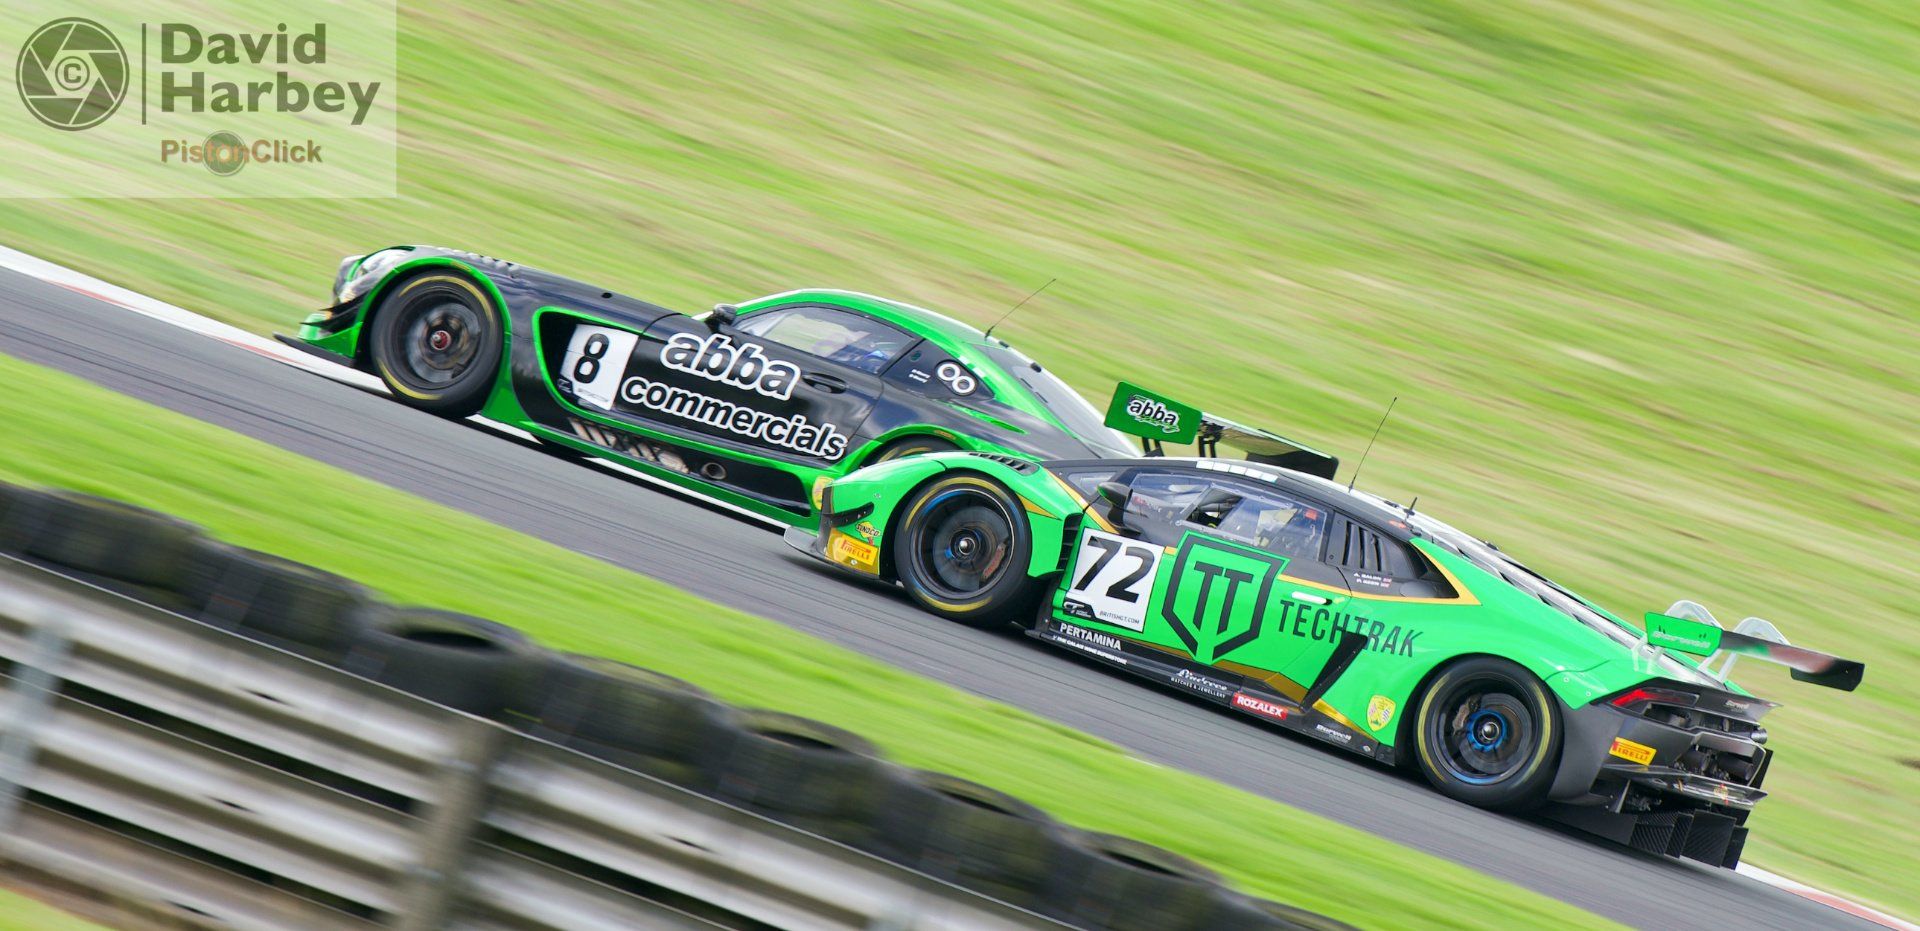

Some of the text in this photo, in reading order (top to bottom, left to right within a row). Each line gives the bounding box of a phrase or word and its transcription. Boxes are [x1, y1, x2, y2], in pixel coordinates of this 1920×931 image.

[573, 332, 610, 385] 8
[660, 332, 801, 401] abba
[620, 376, 849, 461] commercials
[1127, 399, 1179, 427] abba
[856, 523, 881, 537] SUNOCO
[840, 539, 872, 561] PIRELLI
[1073, 535, 1156, 604] 72
[1193, 560, 1253, 636] TT
[1099, 610, 1140, 625] BRITISHGT.COM
[1279, 599, 1424, 658] TECHTRAK
[1059, 622, 1122, 651] PERTAMINA
[1198, 685, 1227, 699] JEWELLERY
[1236, 695, 1284, 718] ROZALEX
[1611, 740, 1650, 762] PIRELLI
